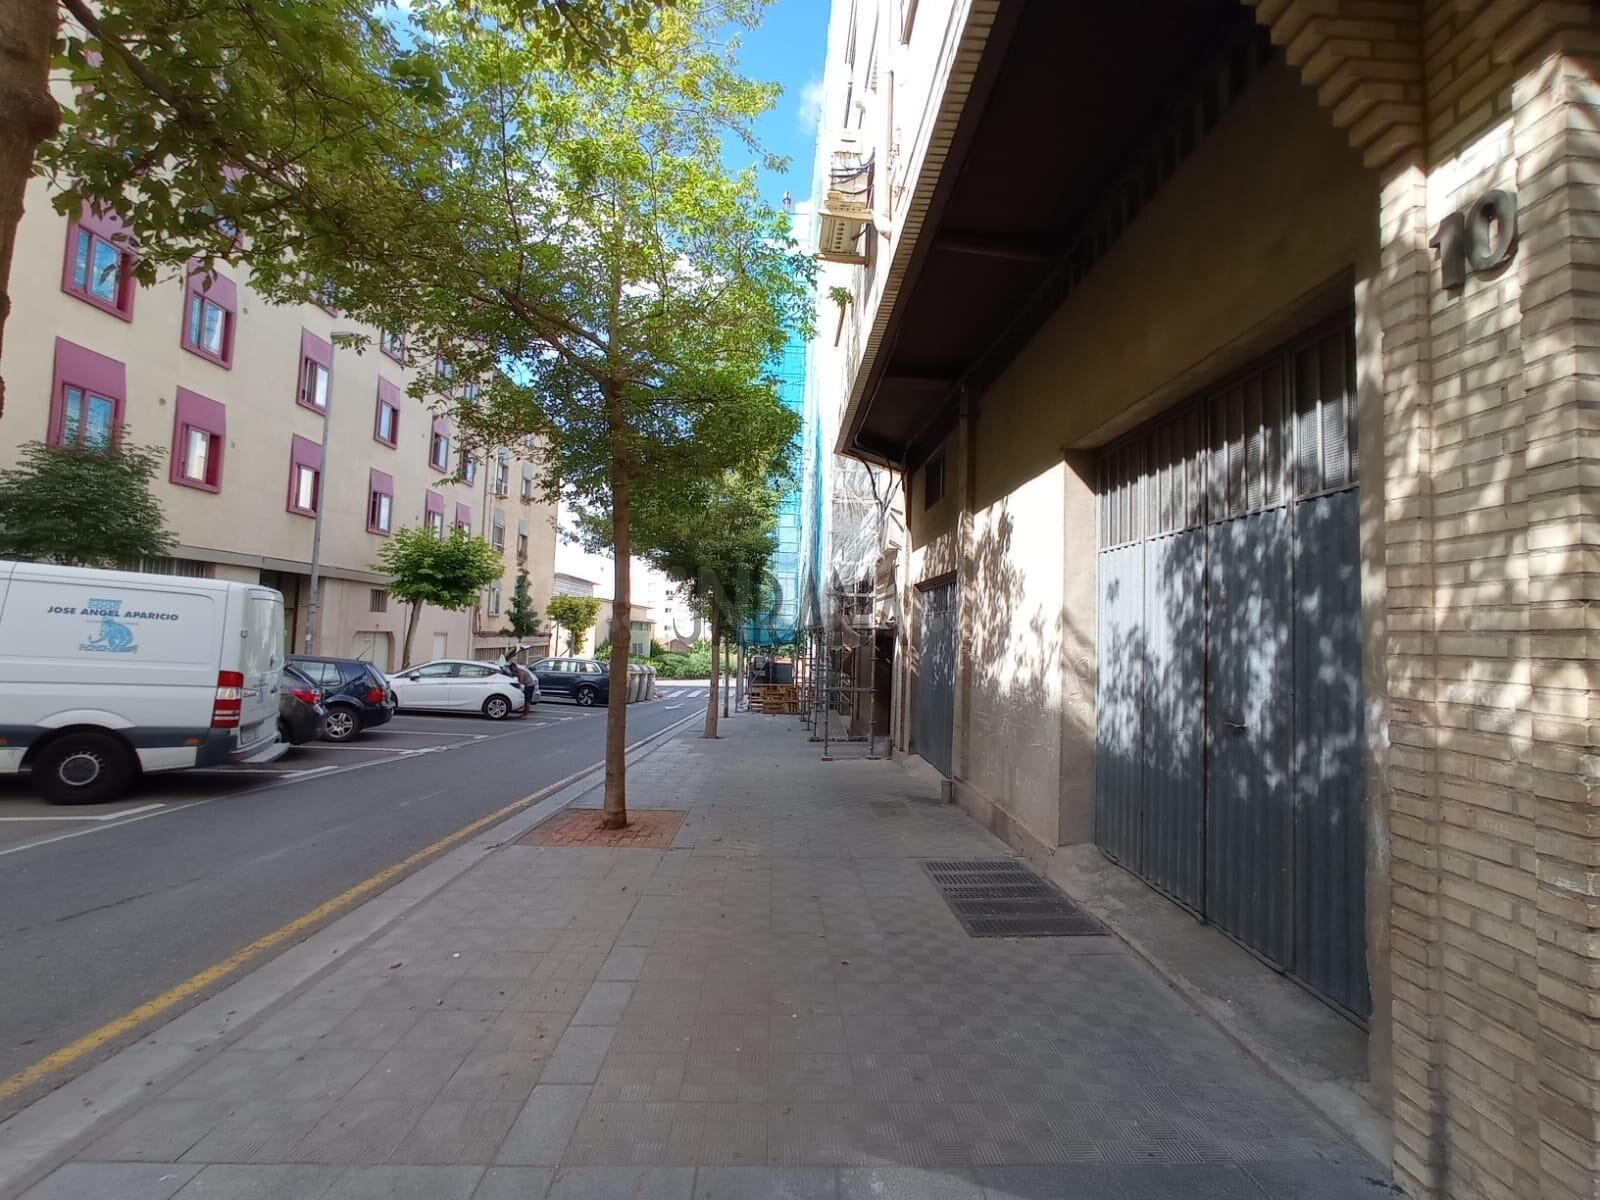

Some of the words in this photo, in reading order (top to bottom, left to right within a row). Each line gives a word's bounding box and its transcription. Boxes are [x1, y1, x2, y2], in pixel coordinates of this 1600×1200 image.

[1429, 189, 1518, 292] 10
[47, 605, 77, 615] JOSE
[80, 608, 120, 617] ANGEL
[124, 611, 179, 620] APARICIO
